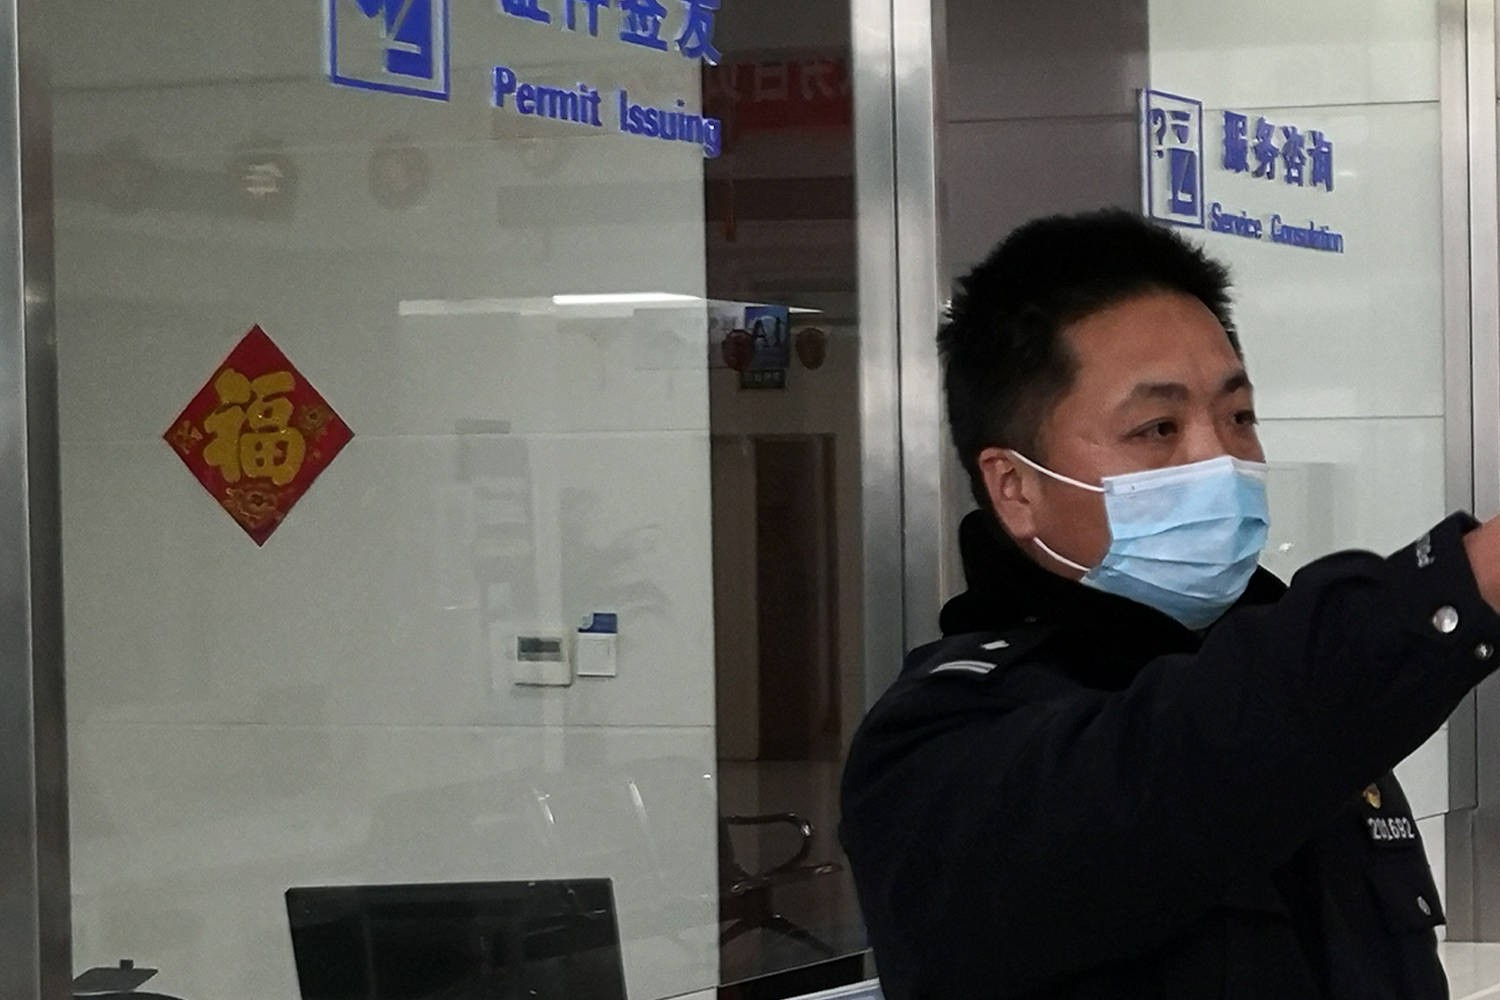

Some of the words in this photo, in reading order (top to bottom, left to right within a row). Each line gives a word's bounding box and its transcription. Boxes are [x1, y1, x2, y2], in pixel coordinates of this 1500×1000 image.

[493, 66, 602, 126] Permit
[618, 89, 721, 157] Issuing
[1222, 111, 1332, 192] 服务咨询
[1211, 202, 1262, 239] Service
[1271, 214, 1344, 253] Consultation
[203, 368, 306, 486] 福
